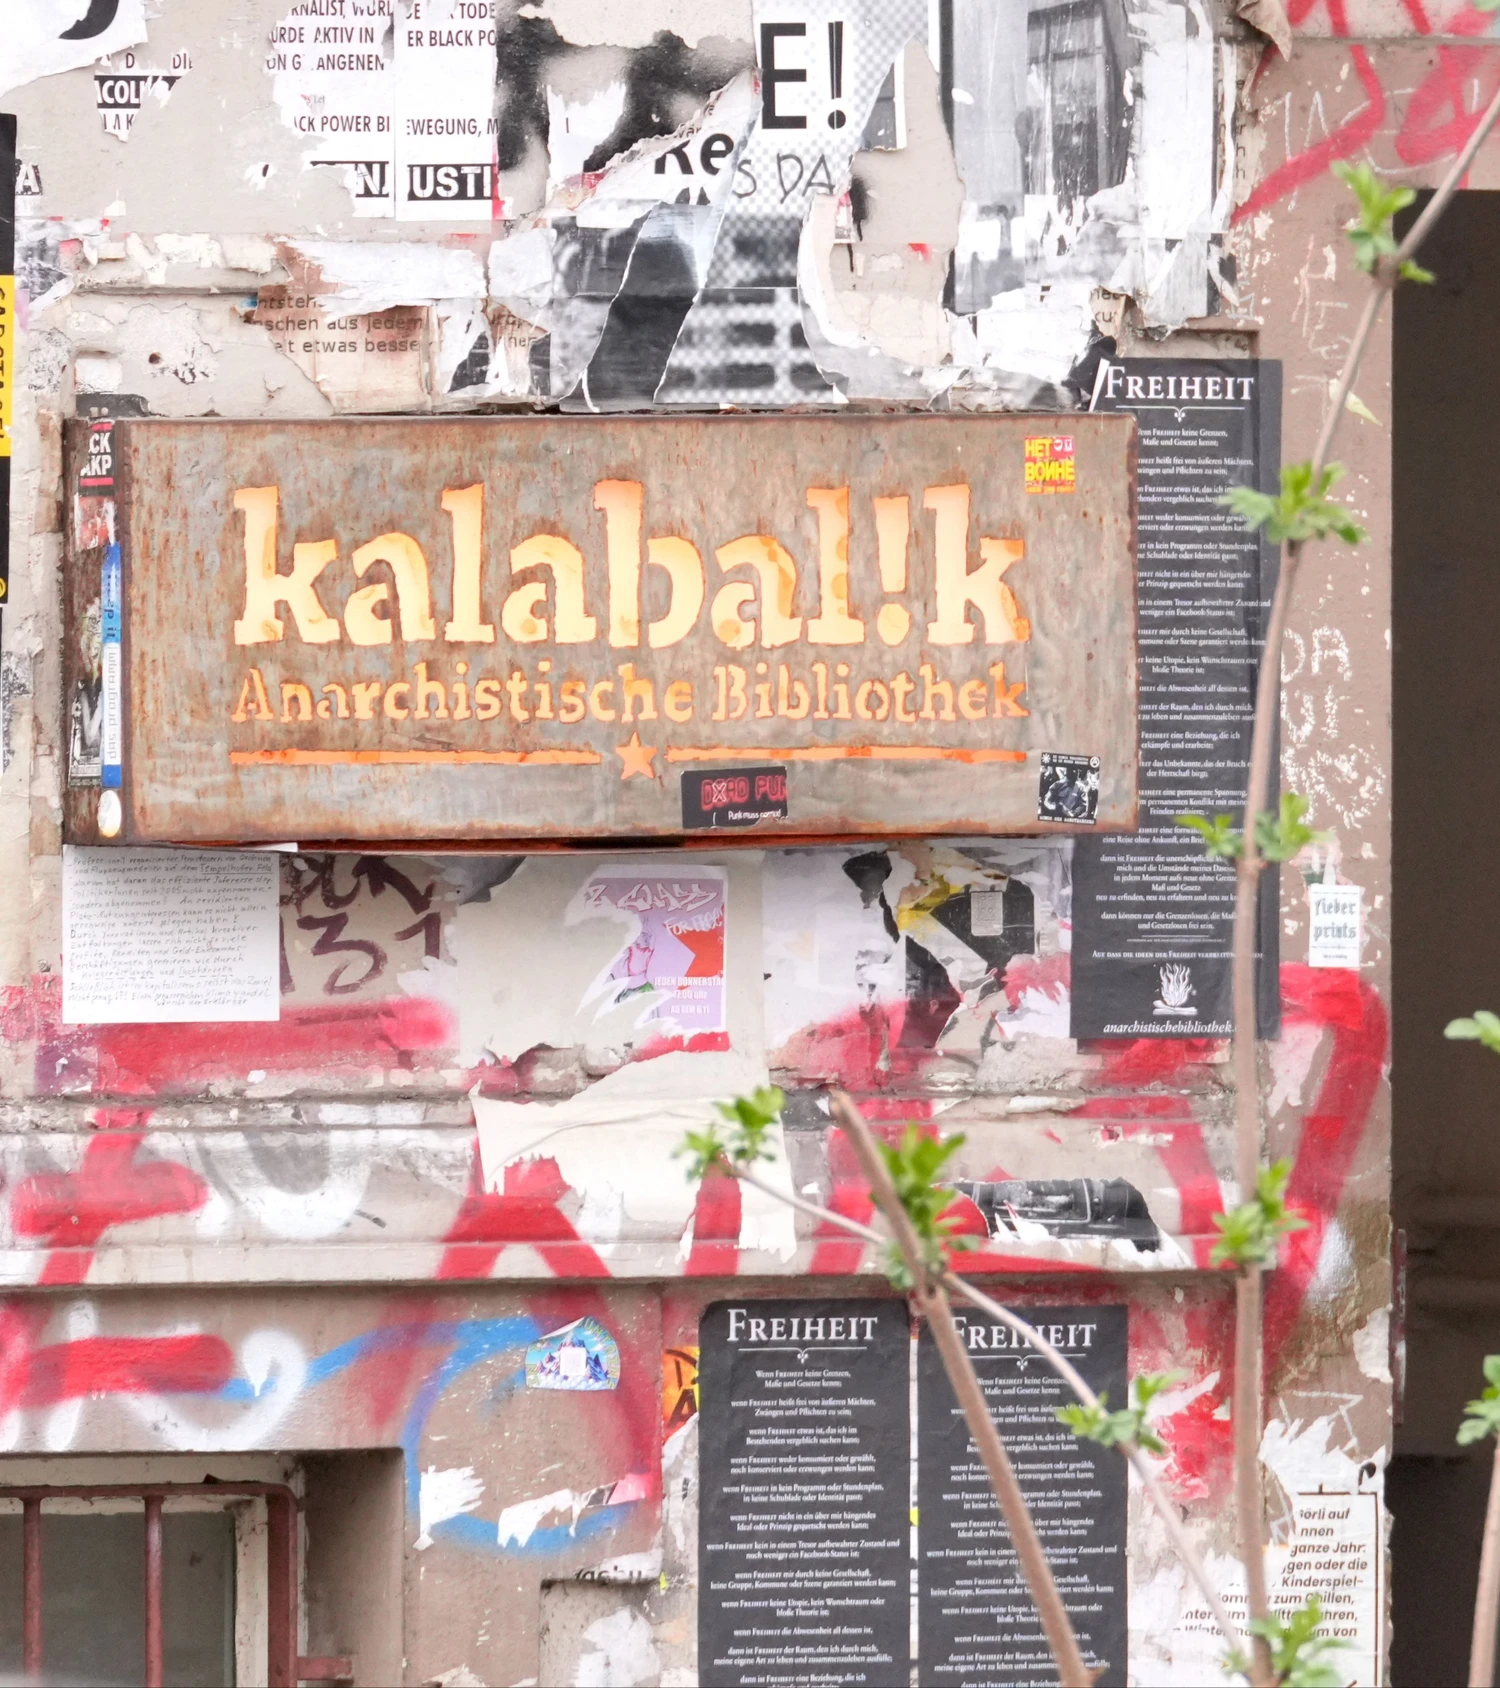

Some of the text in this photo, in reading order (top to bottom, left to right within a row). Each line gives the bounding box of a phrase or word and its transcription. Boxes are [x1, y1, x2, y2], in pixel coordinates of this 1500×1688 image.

[359, 27, 374, 43] IN
[429, 30, 473, 47] BLACK
[761, 21, 847, 129] E!
[294, 116, 316, 132] CK
[321, 116, 371, 132] POWER
[327, 318, 359, 331] aus
[302, 339, 358, 354] etwas
[1104, 365, 1255, 401] FREIHEIT
[233, 479, 1031, 649] kalabal!k
[230, 660, 1031, 724] Anarchistische Bibliothek
[1313, 921, 1357, 942] prints
[1103, 1020, 1238, 1035] anarchistischebibliothek.
[726, 1308, 879, 1342] FREIHEIT
[1328, 1507, 1351, 1520] auf
[1315, 1559, 1345, 1571] oder
[1348, 1559, 1368, 1571] die
[1281, 1575, 1364, 1591] Kinderspiel-
[1274, 1594, 1302, 1605] zum
[1333, 1628, 1357, 1638] von
